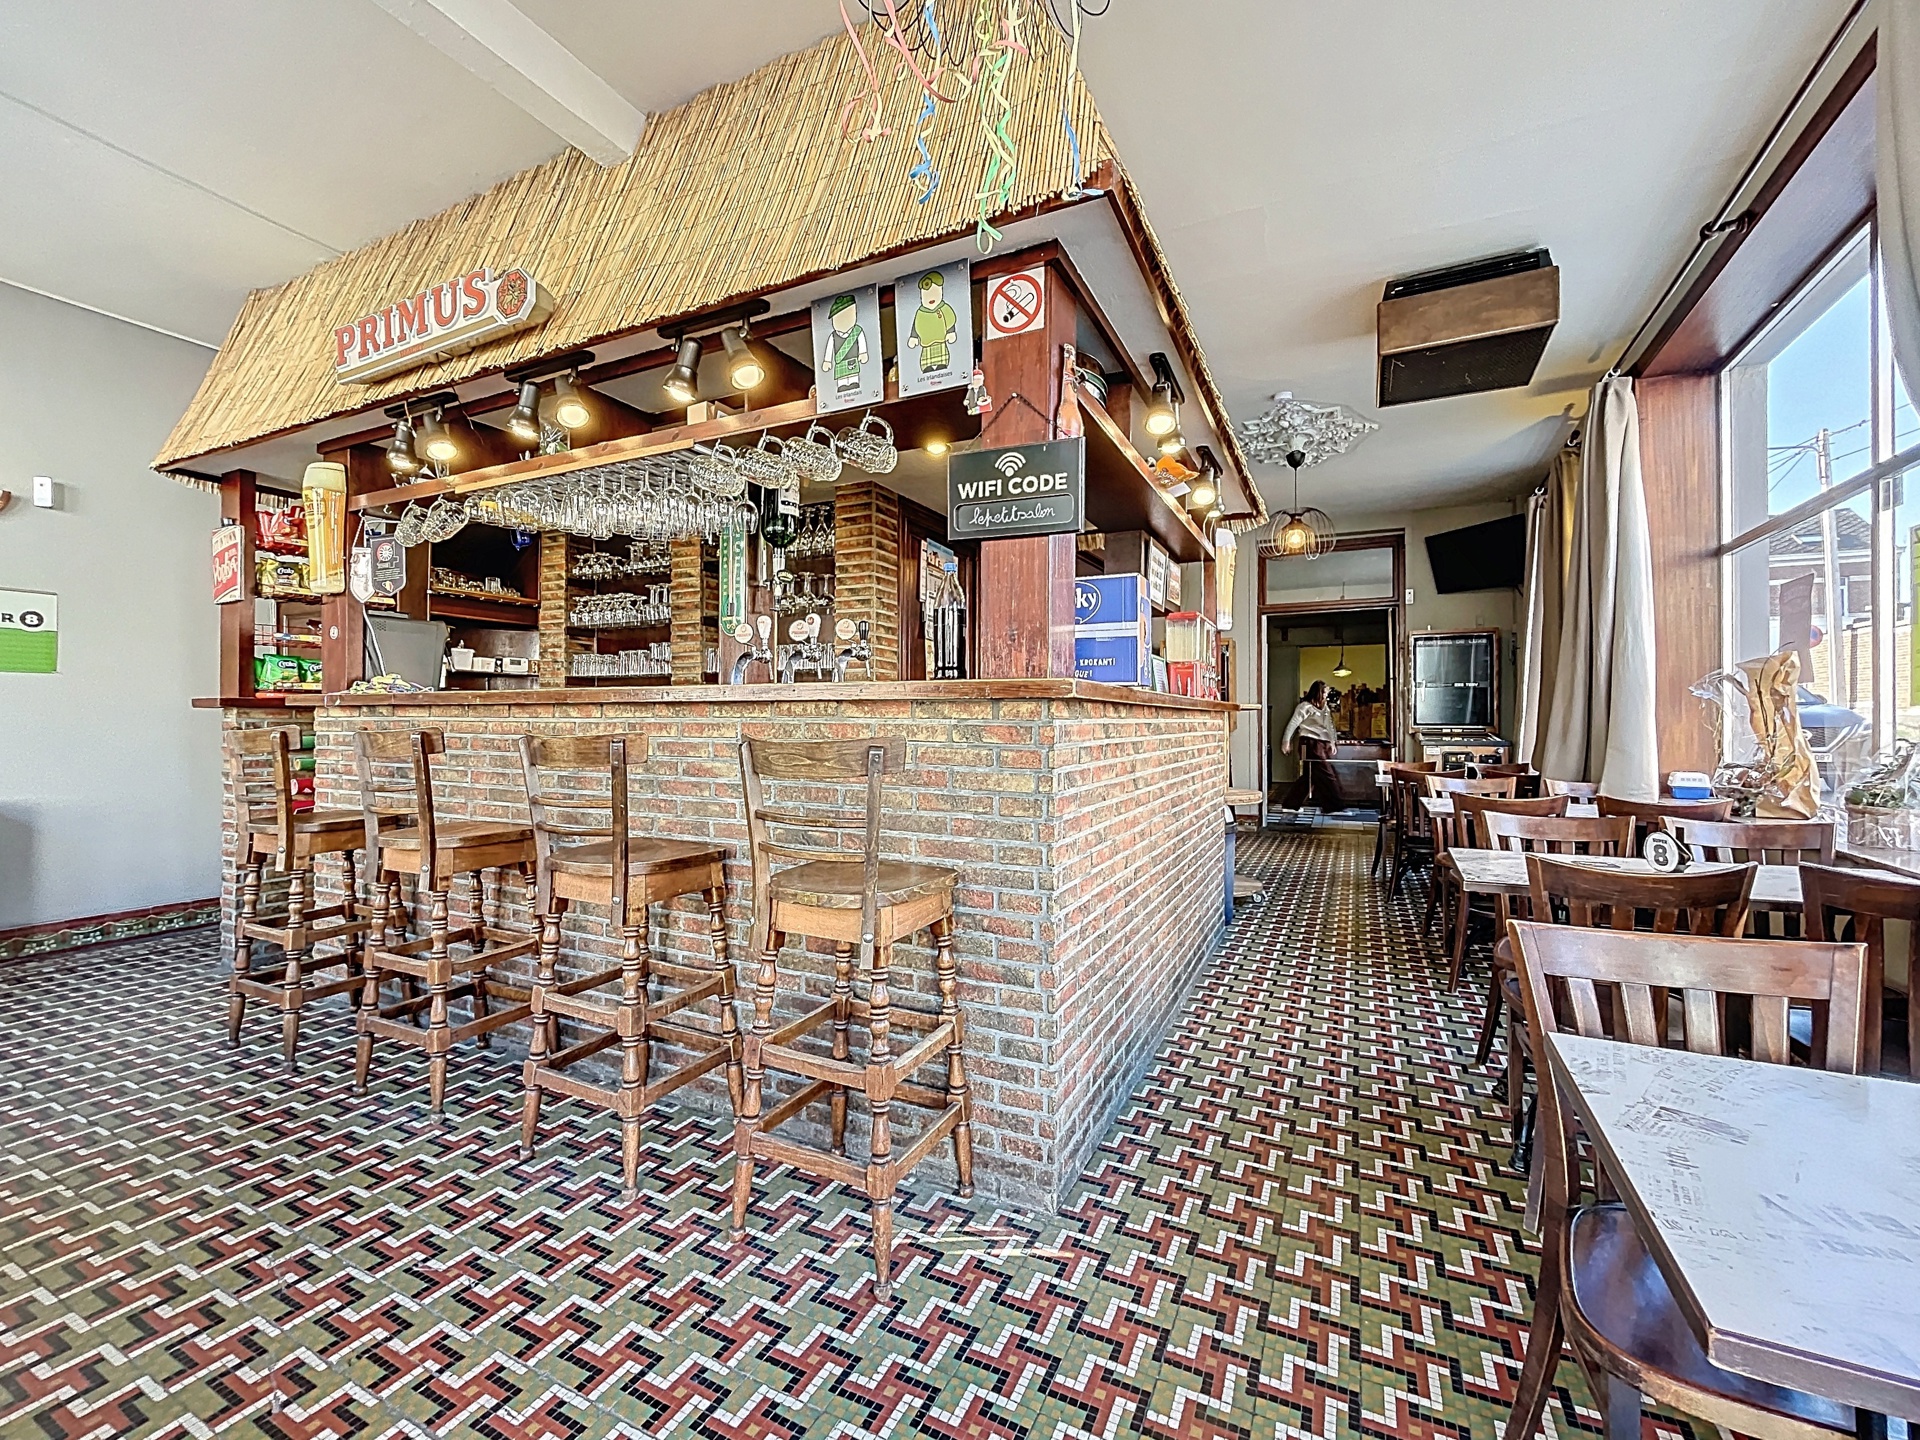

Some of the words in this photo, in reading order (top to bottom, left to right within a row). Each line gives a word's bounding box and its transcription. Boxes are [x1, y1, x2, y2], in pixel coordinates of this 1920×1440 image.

[334, 268, 487, 368] PRIMUS
[957, 479, 1002, 499] WIFI
[1008, 472, 1068, 495] CODE
[1075, 587, 1097, 610] ky
[1653, 844, 1669, 866] 8
